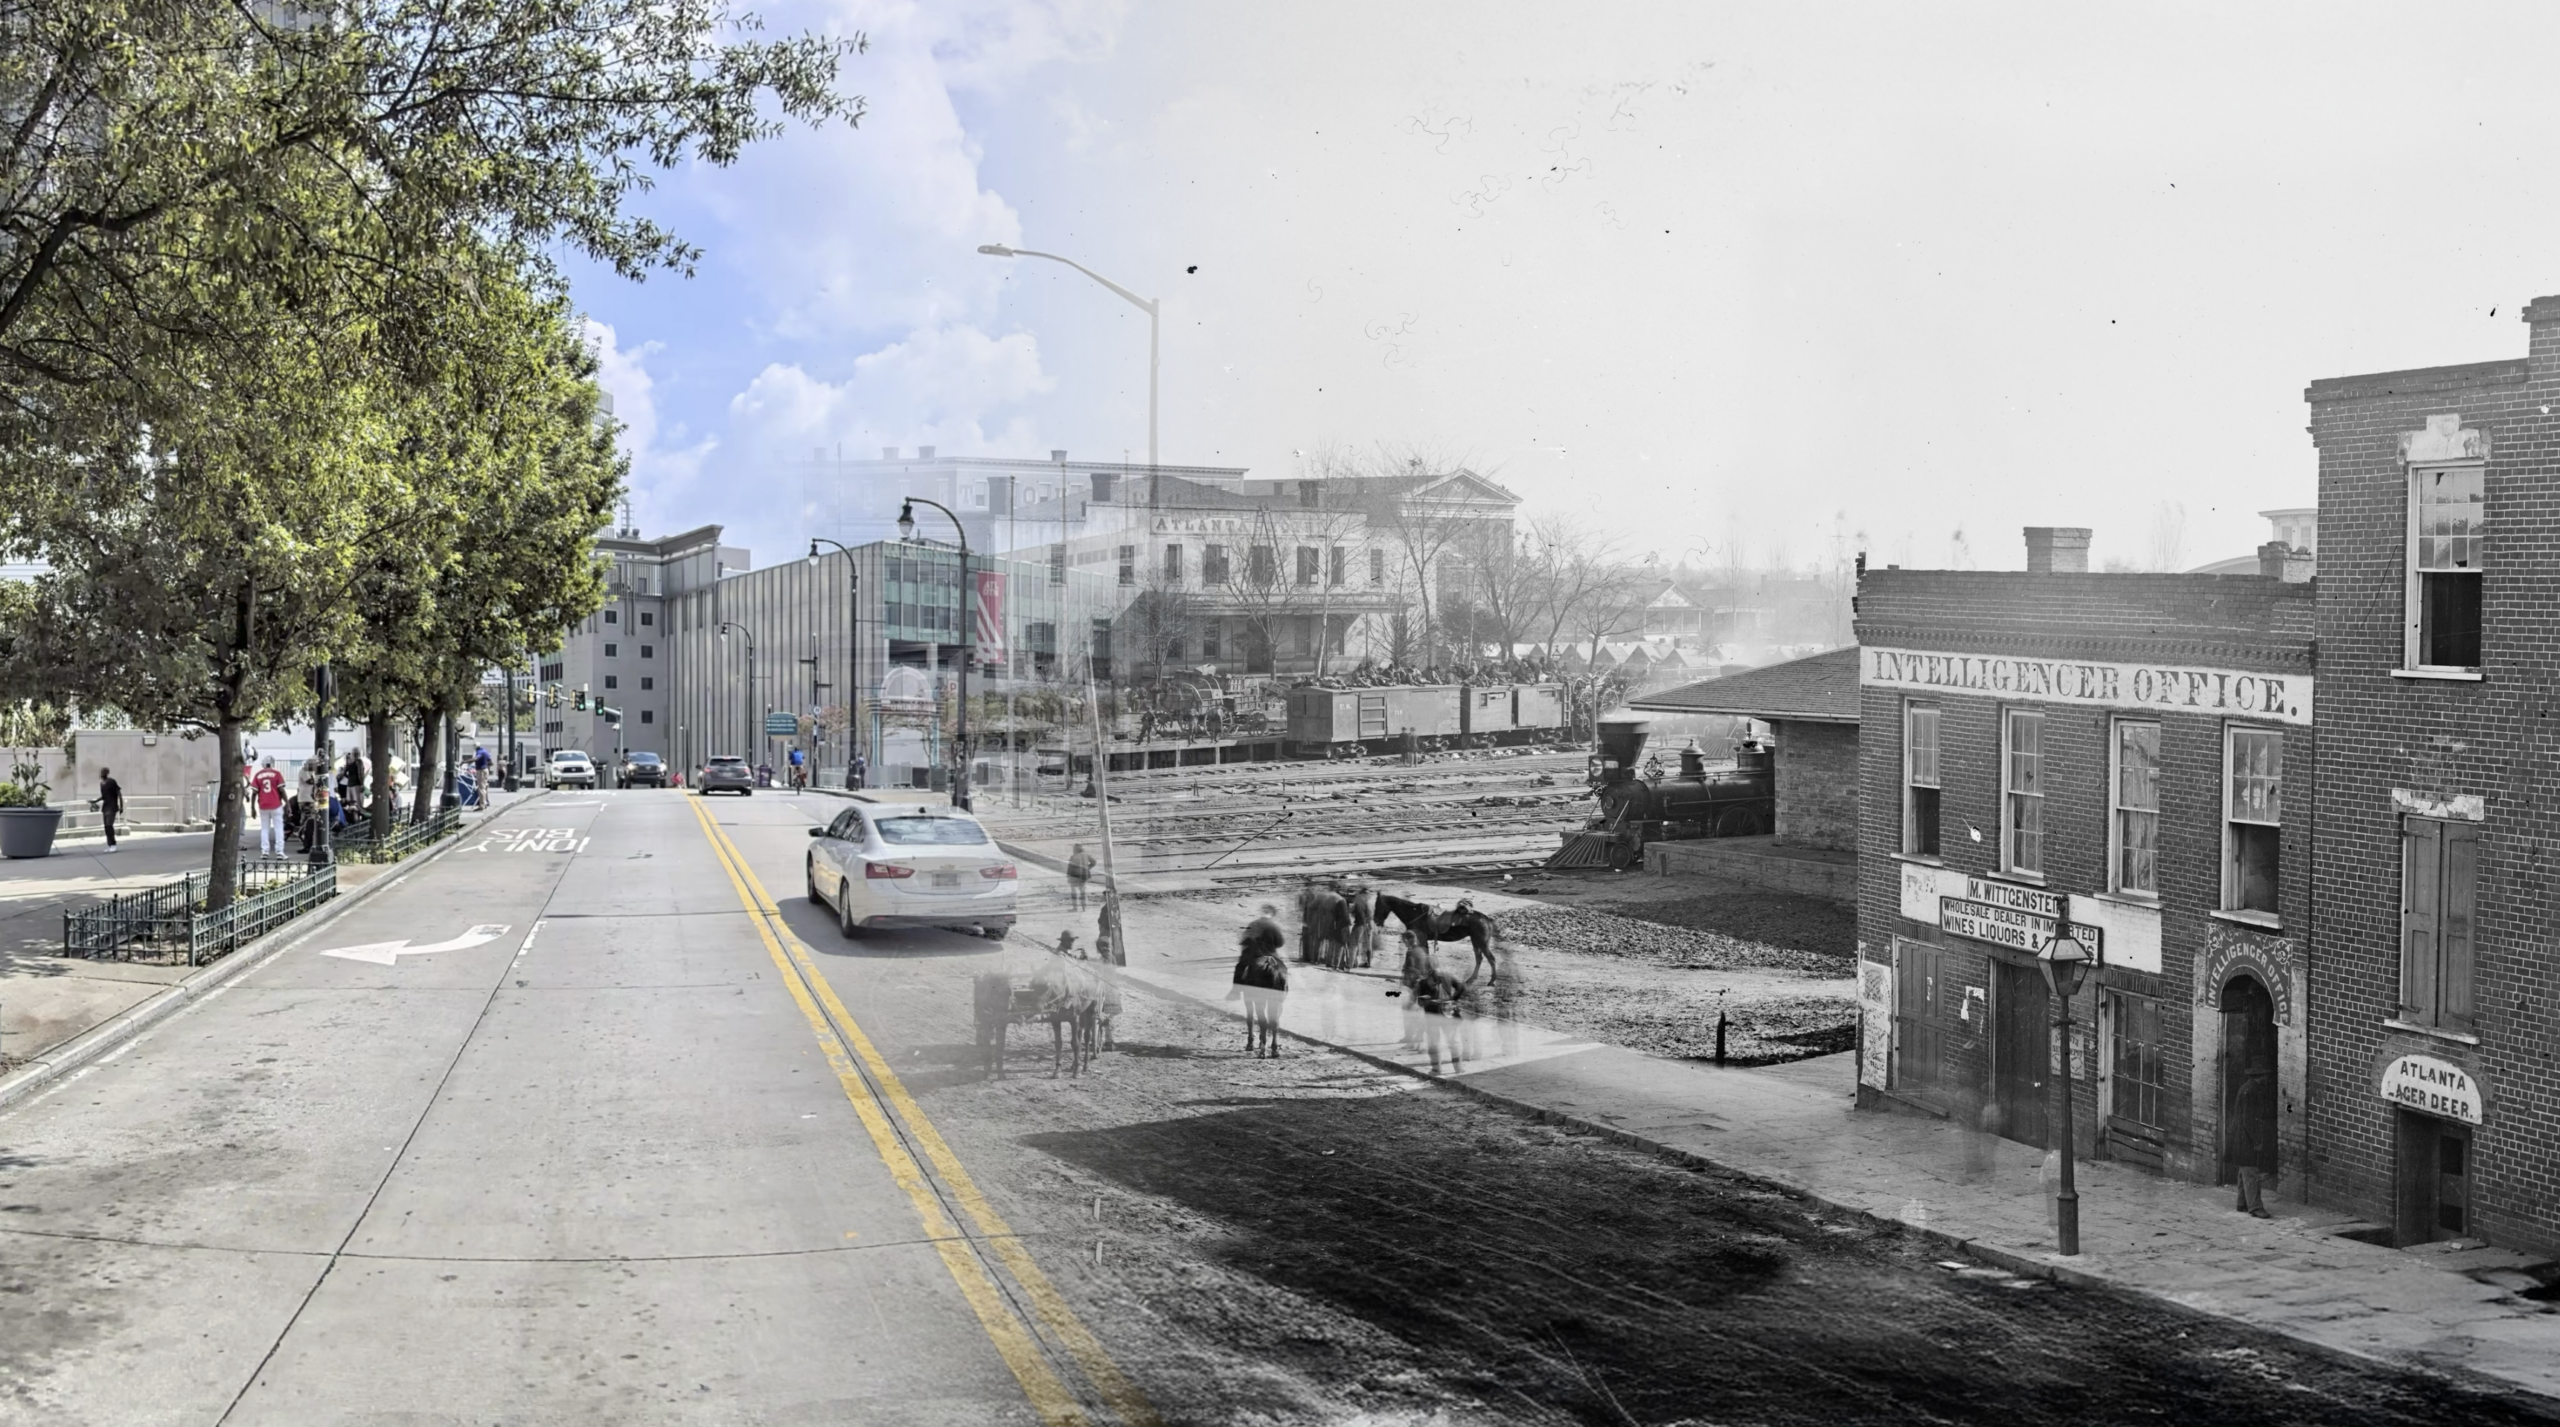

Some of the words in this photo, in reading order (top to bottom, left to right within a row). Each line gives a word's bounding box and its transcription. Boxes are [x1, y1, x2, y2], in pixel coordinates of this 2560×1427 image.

[1155, 518, 1252, 533] ATLANTA
[1873, 651, 2120, 700] INTELLIGENCER
[2134, 669, 2298, 717] OFFICE.
[263, 779, 271, 793] 3
[1969, 881, 1981, 899] M.
[1943, 899, 1990, 920] WHOLESALE
[1994, 909, 2027, 928] DEALER
[2031, 916, 2041, 930] IN
[2043, 919, 2096, 942] IMRTED
[1943, 914, 1975, 935] WINES
[1979, 922, 2026, 946] LIQUORS
[2032, 933, 2040, 950] &
[2208, 942, 2268, 1006] INTELLIGENCER
[2267, 964, 2289, 1026] OFFICE
[2400, 1060, 2467, 1092] ATLANTA
